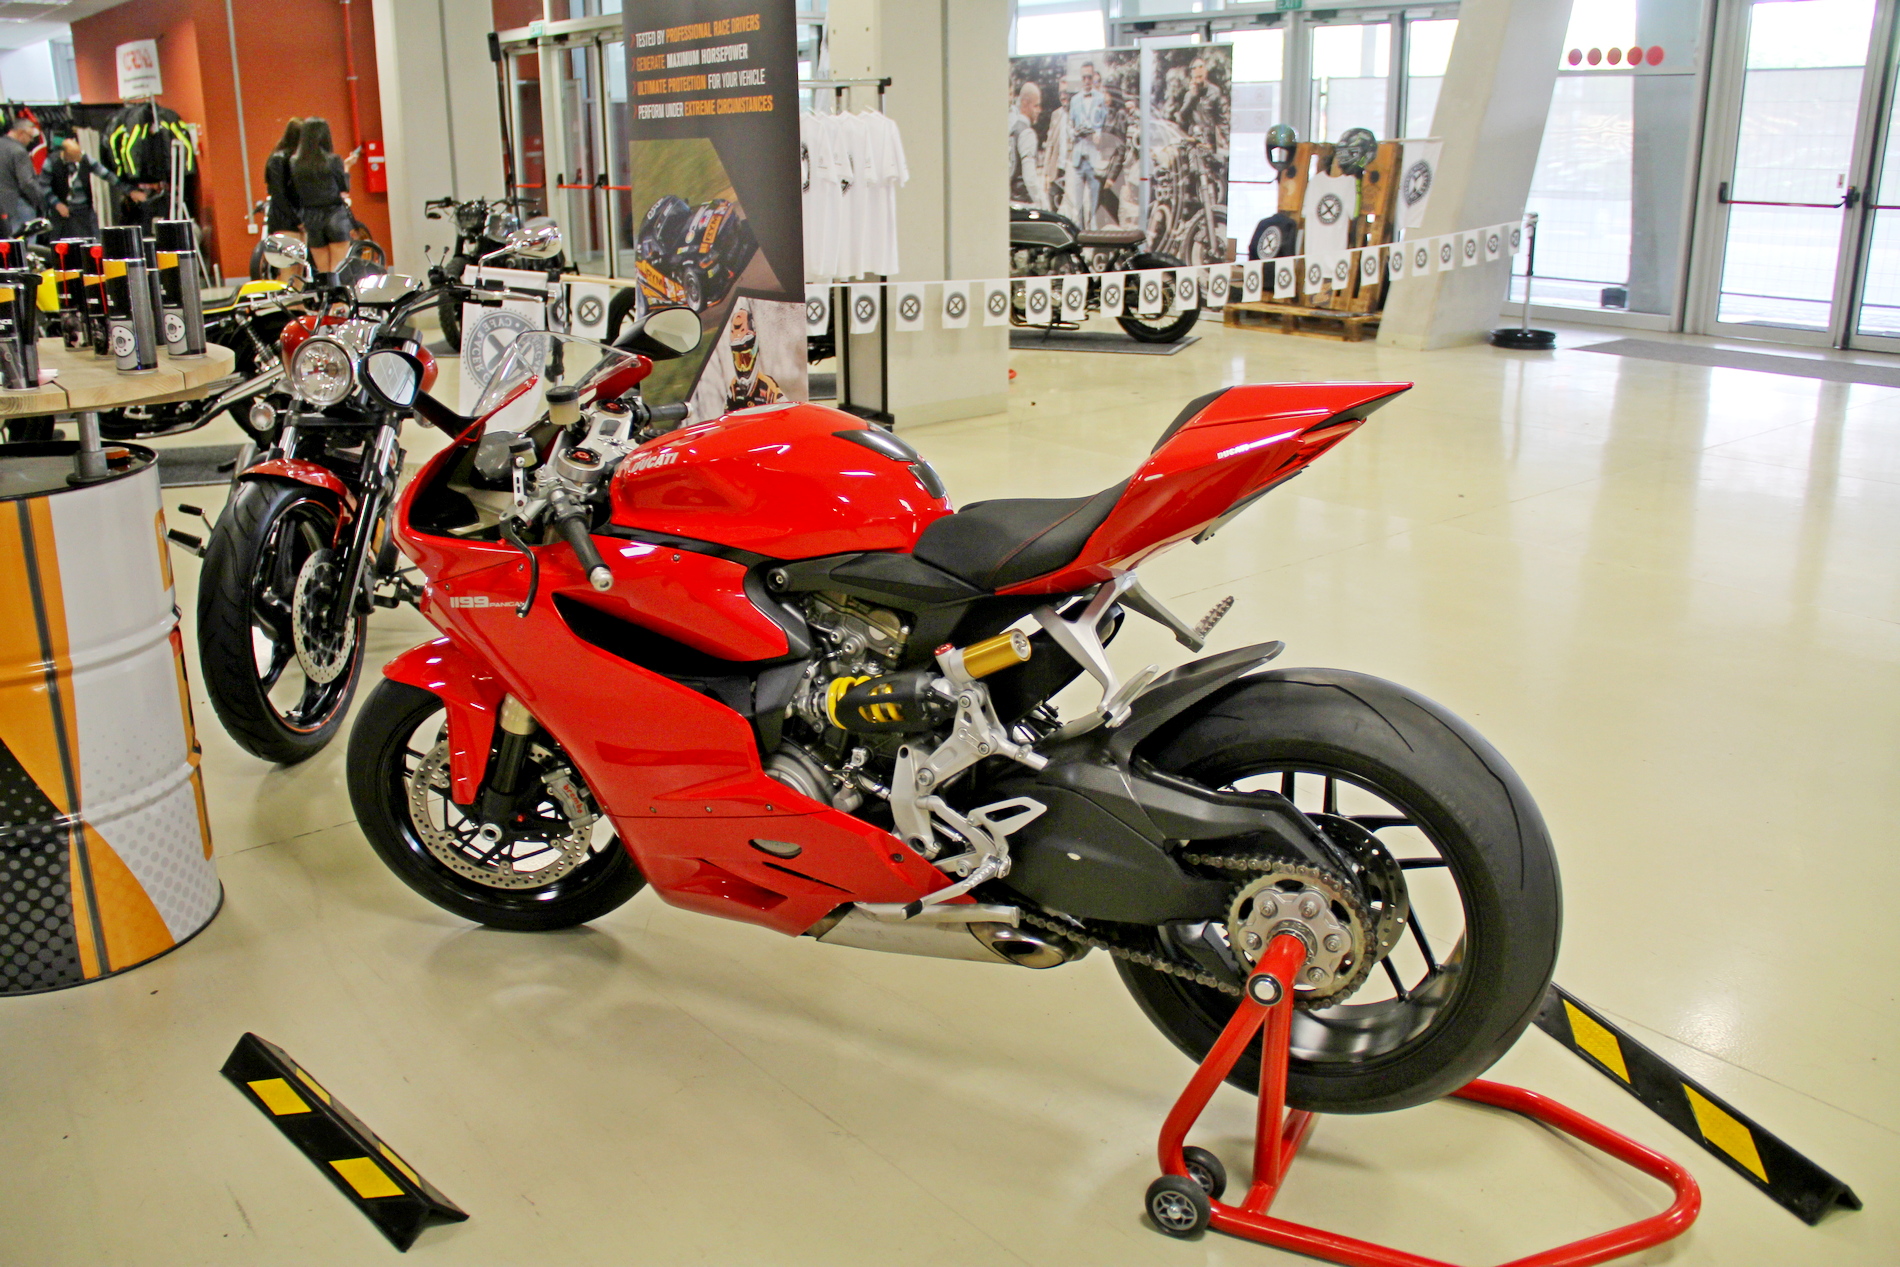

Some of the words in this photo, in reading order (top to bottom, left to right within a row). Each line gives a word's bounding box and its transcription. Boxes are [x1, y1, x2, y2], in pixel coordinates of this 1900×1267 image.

[635, 31, 656, 48] TESTED
[657, 30, 665, 45] BY
[666, 23, 712, 43] PROFESSIONAL
[713, 19, 731, 36] RACE
[731, 14, 760, 34] DRIVERS
[636, 54, 666, 72] GENERATE
[667, 50, 700, 68] MAXIMUM
[701, 43, 749, 64] HORSEPOWER
[637, 79, 667, 95] ULTIMATE
[668, 75, 707, 92] PROTECTION
[708, 73, 721, 89] FOR
[722, 71, 738, 88] YOUR
[739, 68, 766, 86] VEHICLE
[638, 103, 665, 119] PERFORM
[665, 102, 684, 118] UNDER
[685, 100, 716, 116] EXTREME
[716, 95, 773, 114] CIRCUMSTANCES
[629, 452, 679, 473] DUCATI
[449, 595, 490, 609] 1199
[563, 783, 584, 814] brembo
